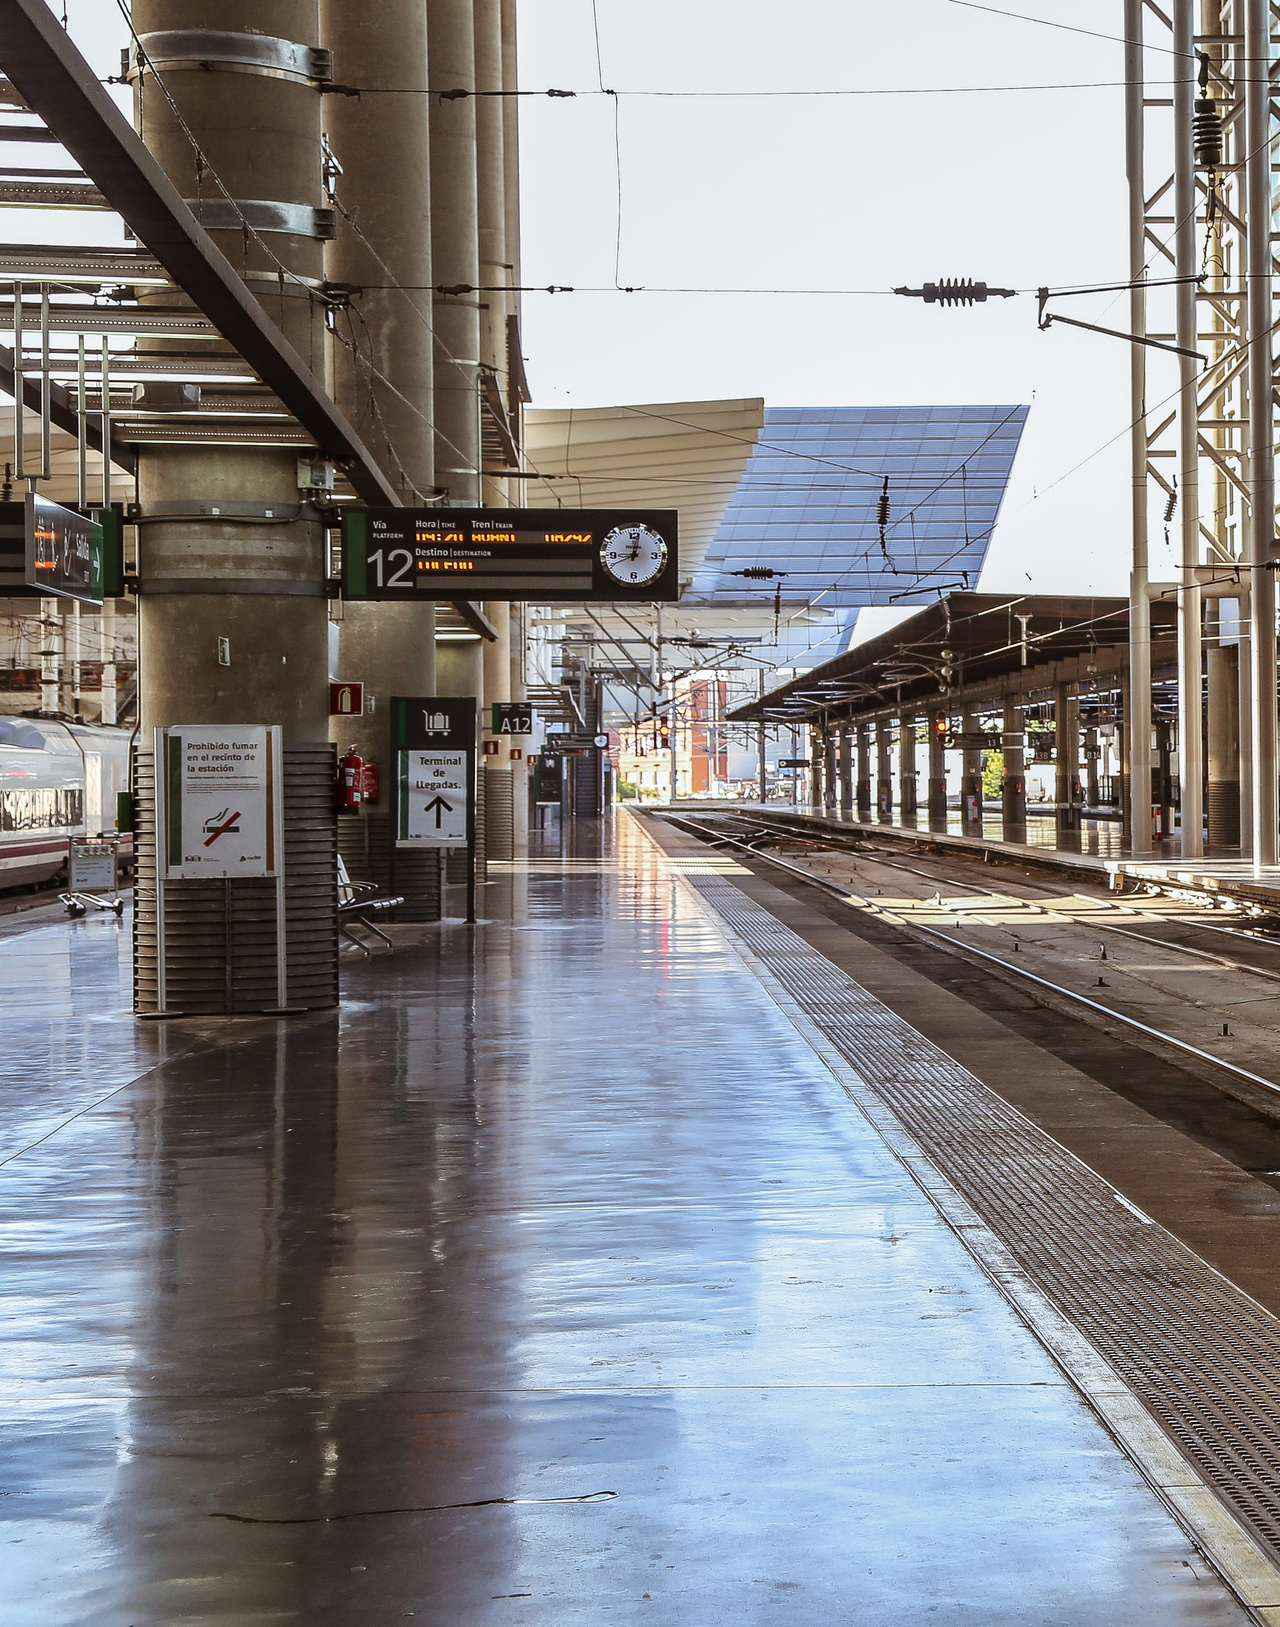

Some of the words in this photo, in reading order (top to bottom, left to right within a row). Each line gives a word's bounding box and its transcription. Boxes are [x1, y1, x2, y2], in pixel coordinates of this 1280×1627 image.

[415, 520, 436, 528] Hora
[471, 520, 490, 528] Tren
[415, 548, 449, 557] Destino
[367, 549, 414, 587] 12
[500, 717, 531, 732] A12
[187, 742, 229, 750] Prohibido
[232, 742, 258, 750] fumar
[201, 753, 209, 761] el
[211, 753, 242, 761] recinto
[244, 753, 255, 761] de
[419, 757, 462, 765] Terminal
[187, 765, 195, 773] la
[198, 764, 234, 773] estación
[432, 769, 445, 777] de
